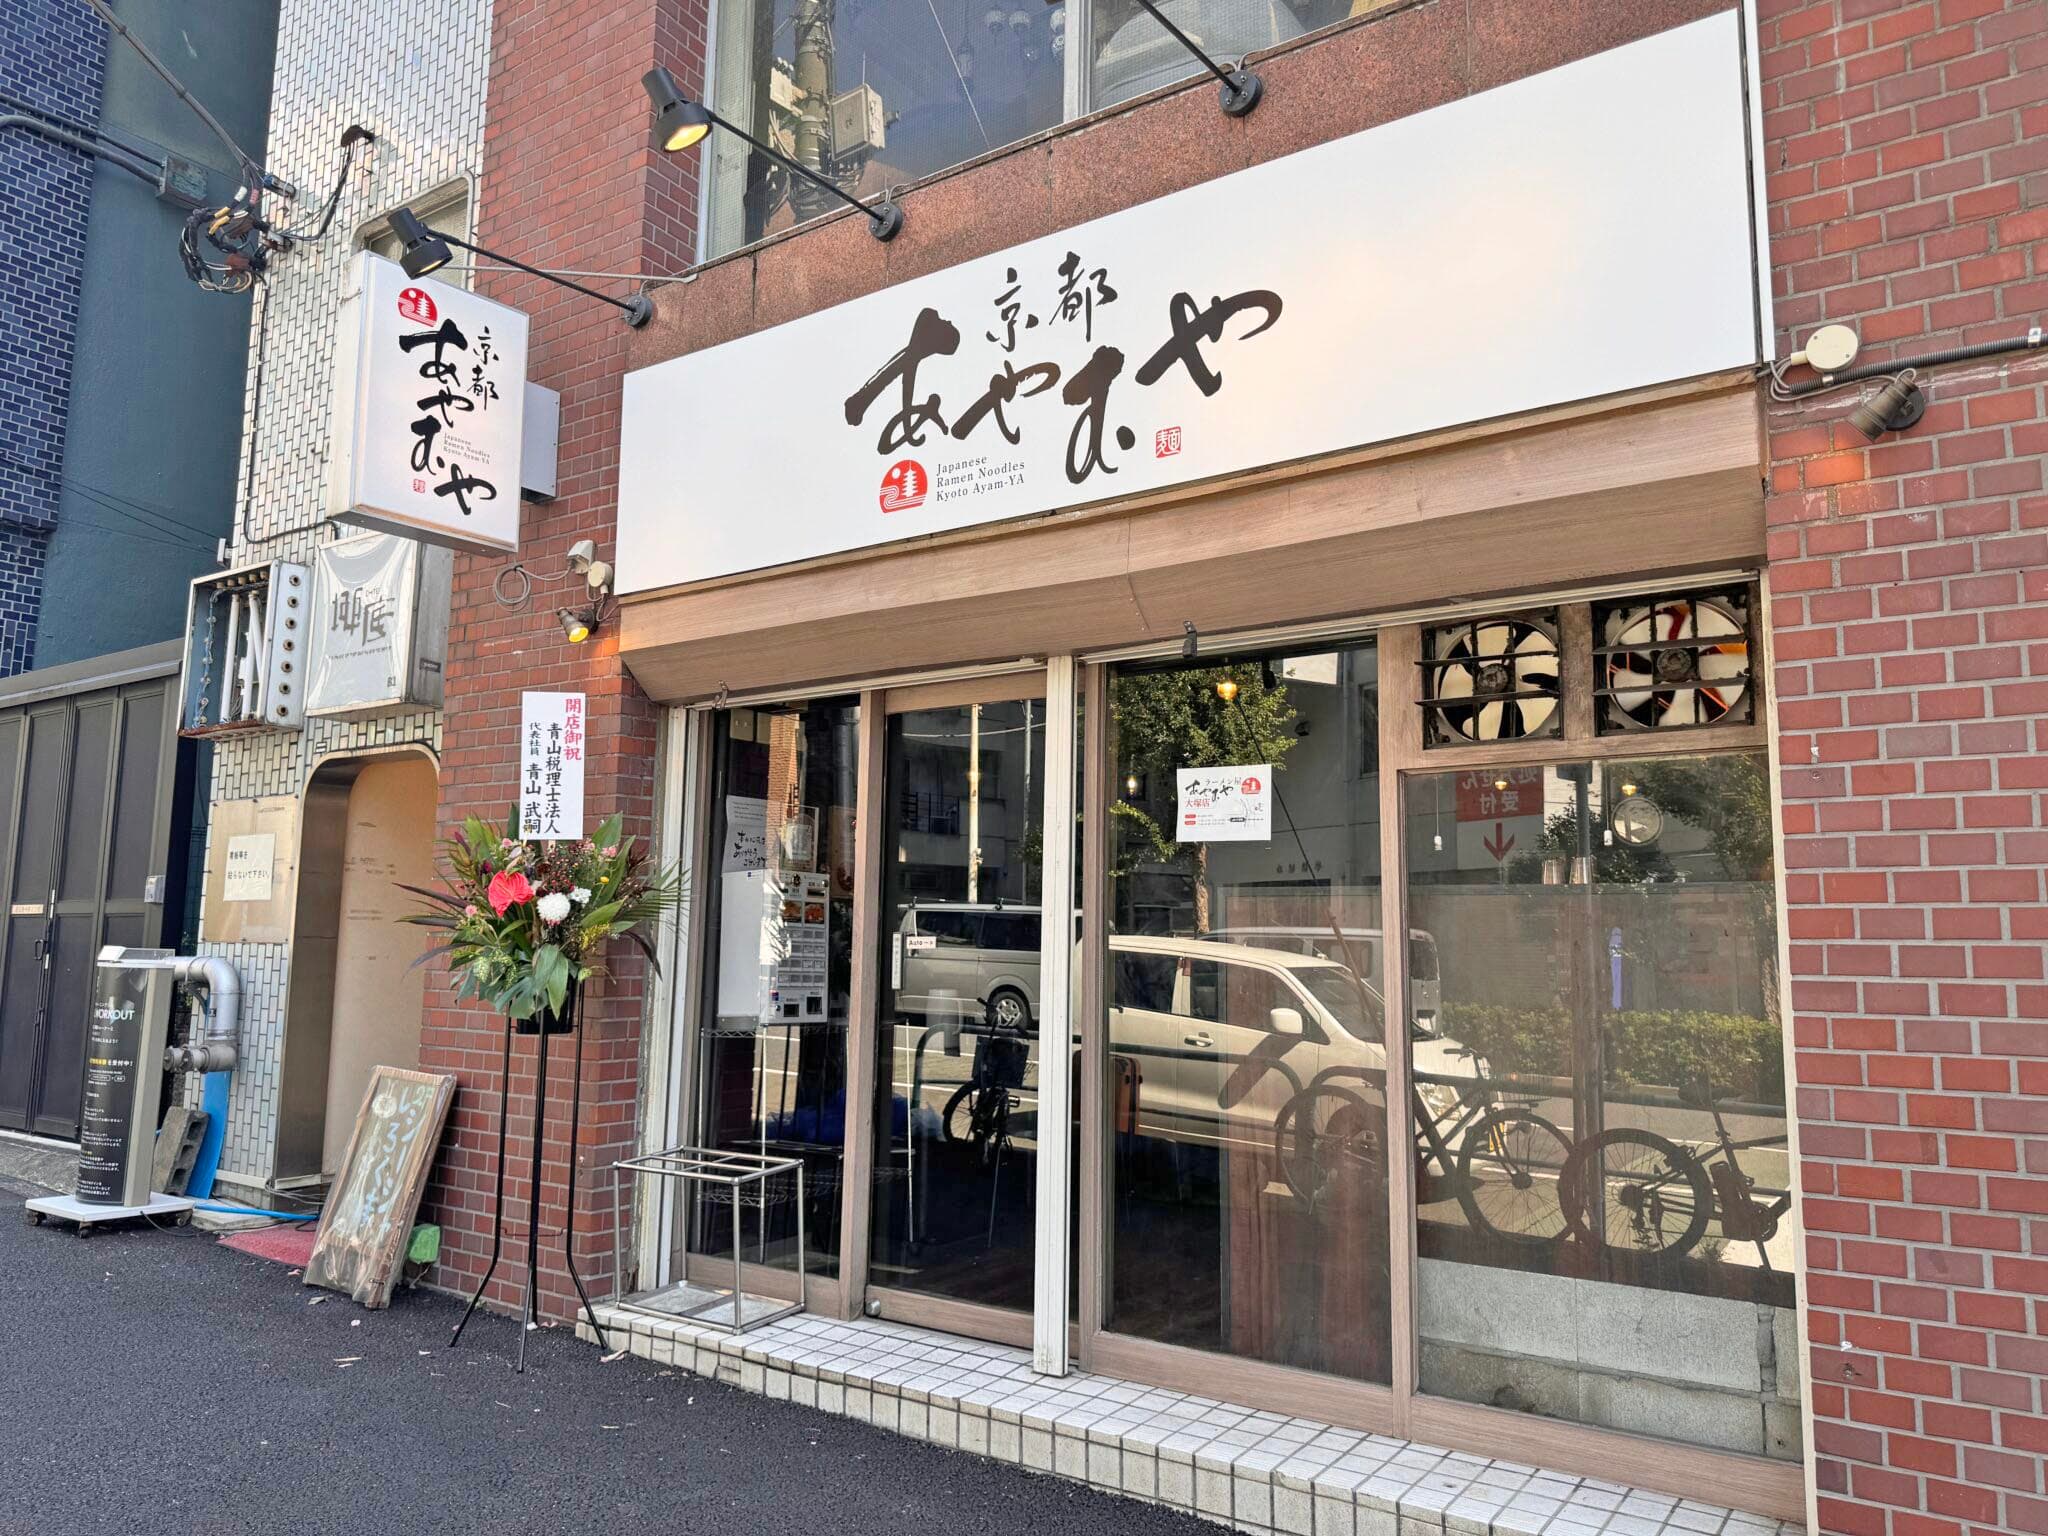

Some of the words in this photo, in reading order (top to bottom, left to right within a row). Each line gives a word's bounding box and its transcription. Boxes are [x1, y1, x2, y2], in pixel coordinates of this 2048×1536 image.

[985, 251, 1118, 351] 京都
[466, 326, 500, 411] 京都
[845, 290, 1283, 485] あやむや
[399, 318, 498, 516] あやむや
[1155, 427, 1182, 459] 麺
[936, 455, 988, 476] Japanese
[936, 473, 974, 488] Ramen
[978, 461, 1026, 479] Noodles
[936, 487, 969, 502] Kyoto
[973, 474, 1025, 497] Ayam-YA
[530, 722, 542, 756] 代表社員
[563, 698, 582, 761] 開店御祝
[525, 763, 542, 796] 青山
[544, 722, 563, 834] 青山税理士法人
[1185, 798, 1211, 808] 大塚店
